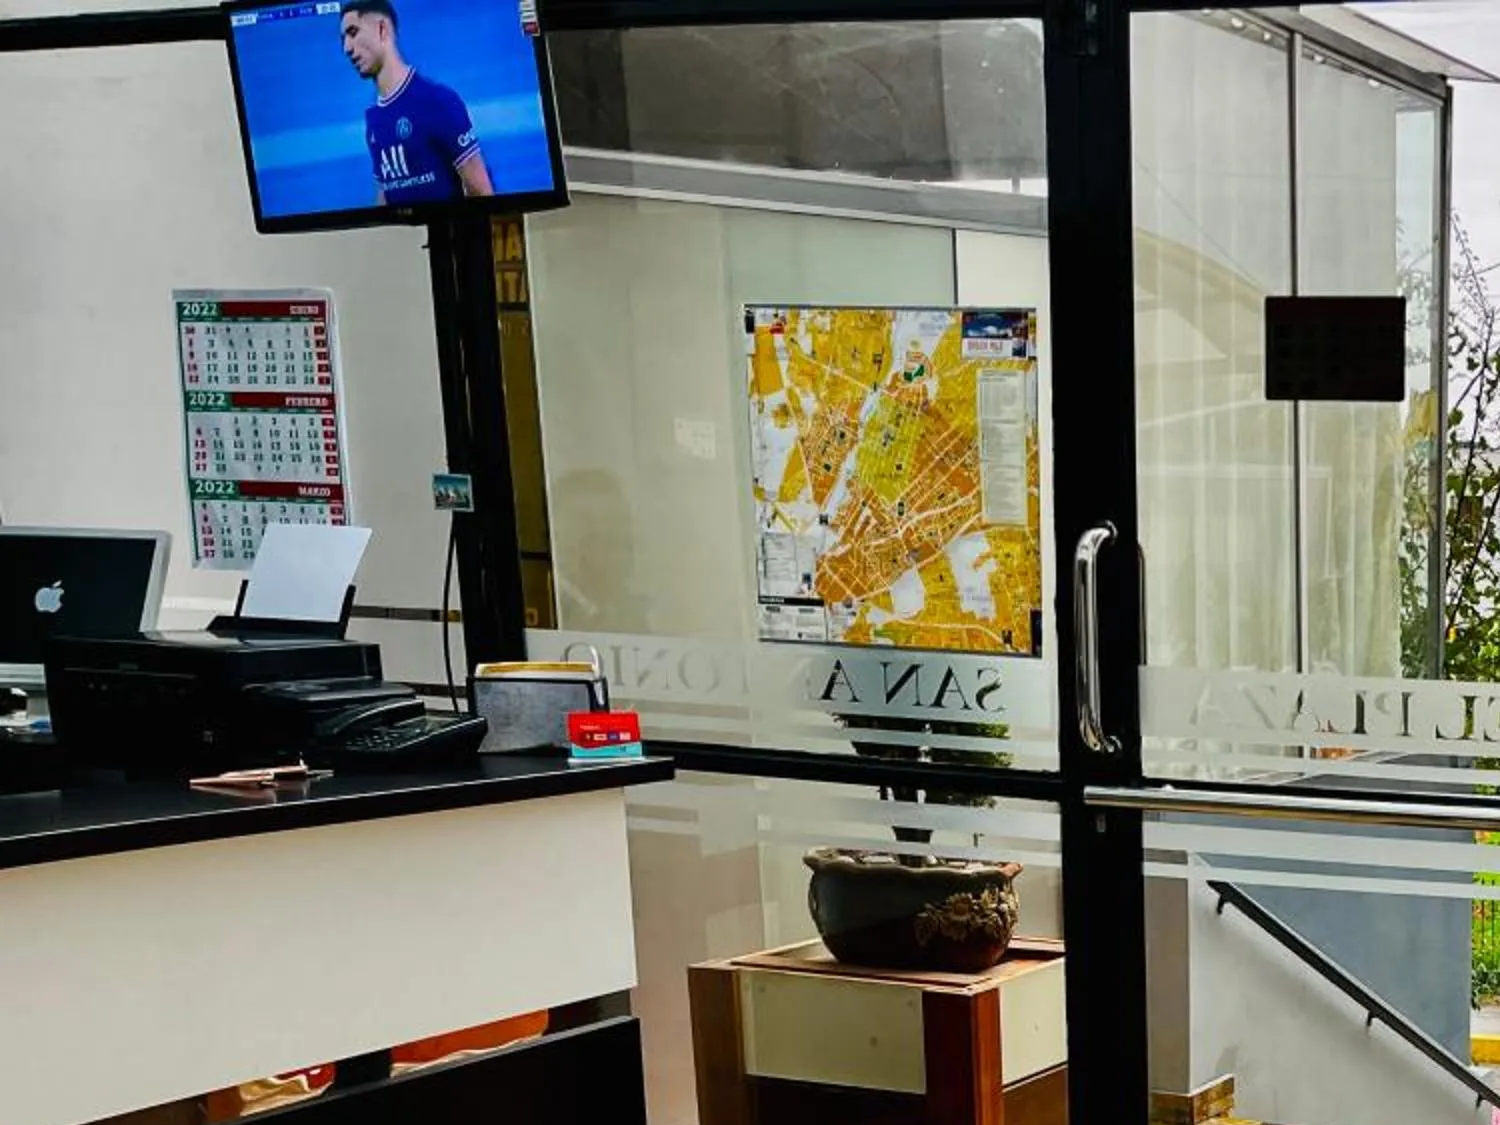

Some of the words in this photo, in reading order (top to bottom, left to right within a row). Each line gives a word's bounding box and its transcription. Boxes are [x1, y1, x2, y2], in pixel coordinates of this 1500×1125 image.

[183, 304, 218, 315] 2022
[190, 394, 225, 405] 2022
[195, 482, 235, 494] 2022
